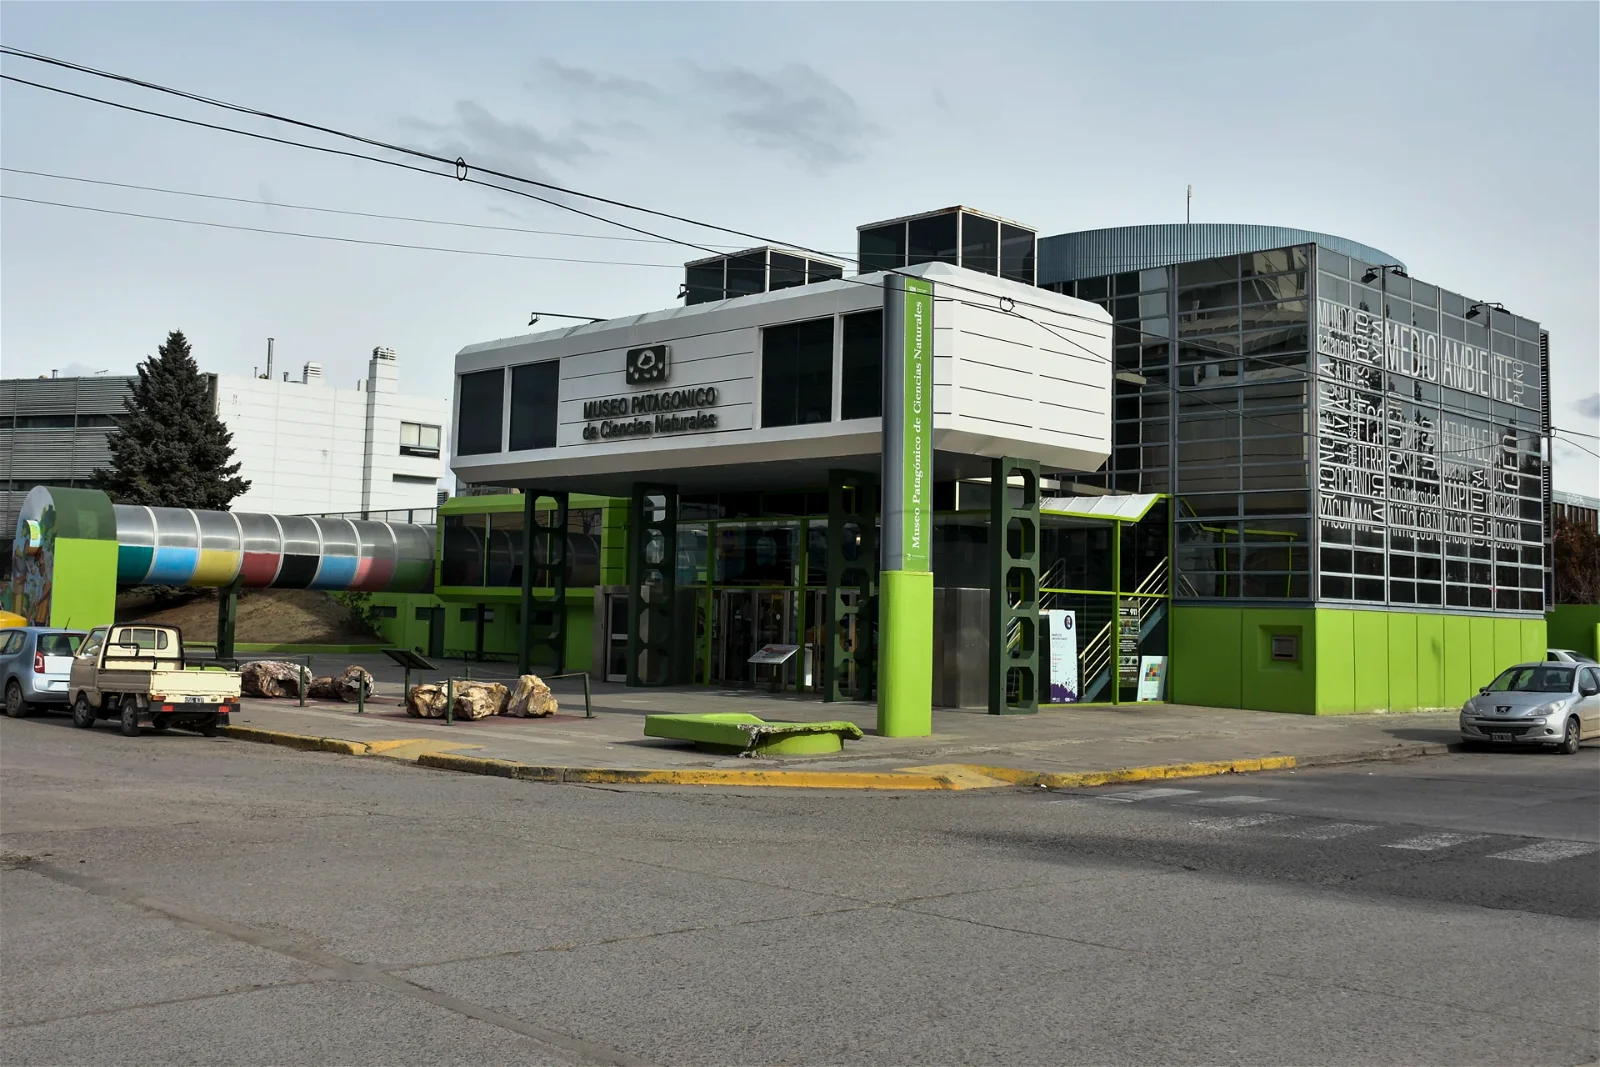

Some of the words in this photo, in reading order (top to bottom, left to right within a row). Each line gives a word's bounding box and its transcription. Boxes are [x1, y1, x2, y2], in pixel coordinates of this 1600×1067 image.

[913, 301, 923, 360] Naturales
[1385, 321, 1437, 382] MEDIO
[1443, 340, 1513, 403] AMBIENTE
[1512, 360, 1524, 406] PURO
[583, 397, 629, 420] MUSEO
[631, 386, 717, 414] PATAGONICO
[913, 362, 923, 414] Ciencias
[583, 421, 599, 440] de
[600, 417, 651, 439] Ciencias
[654, 411, 717, 434] Naturales
[912, 417, 922, 433] de
[1319, 362, 1336, 500] CONCIENCIA
[912, 436, 924, 505] Patagónico
[1357, 445, 1385, 474] TIERR
[911, 507, 921, 549] Museo
[1472, 469, 1485, 547] CULTURA
